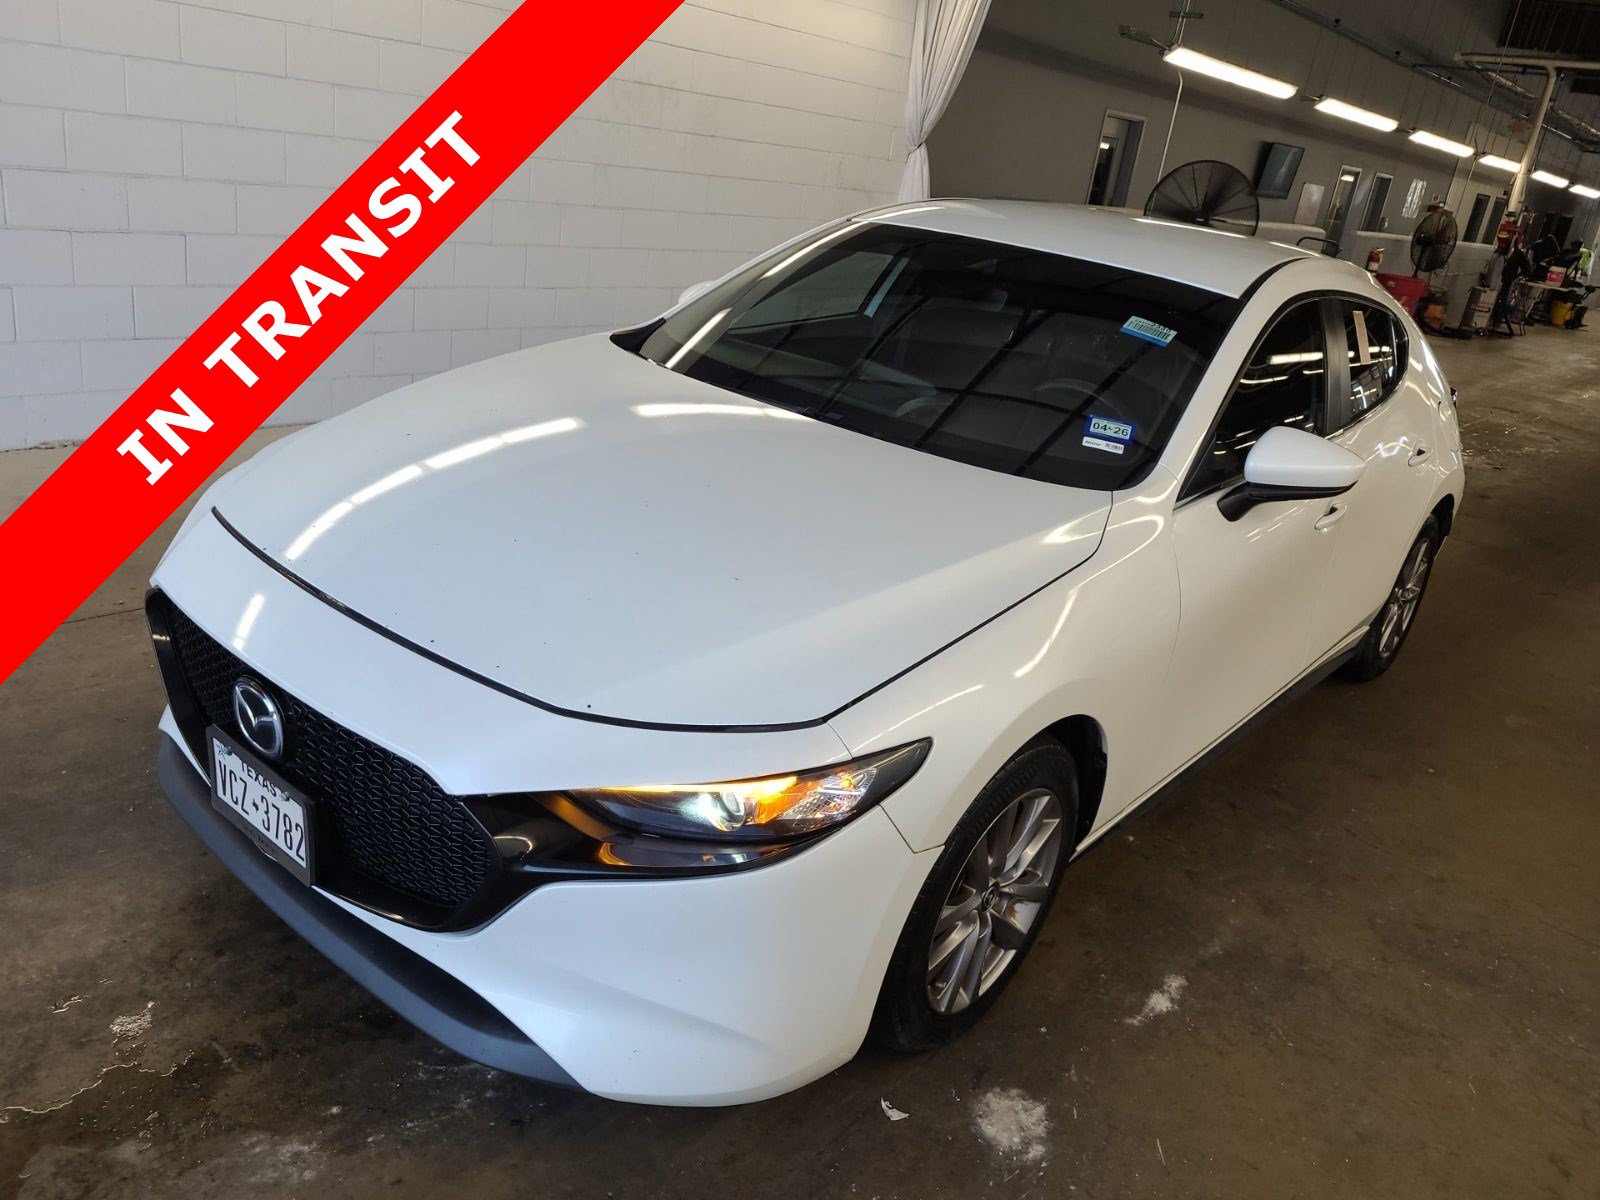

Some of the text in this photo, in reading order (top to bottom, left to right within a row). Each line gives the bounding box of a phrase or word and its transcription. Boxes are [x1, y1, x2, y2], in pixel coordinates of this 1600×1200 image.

[1093, 422, 1129, 437] 04 26
[241, 762, 277, 797] TEXAS
[218, 760, 249, 816] VCZ
[260, 794, 305, 862] 3782
